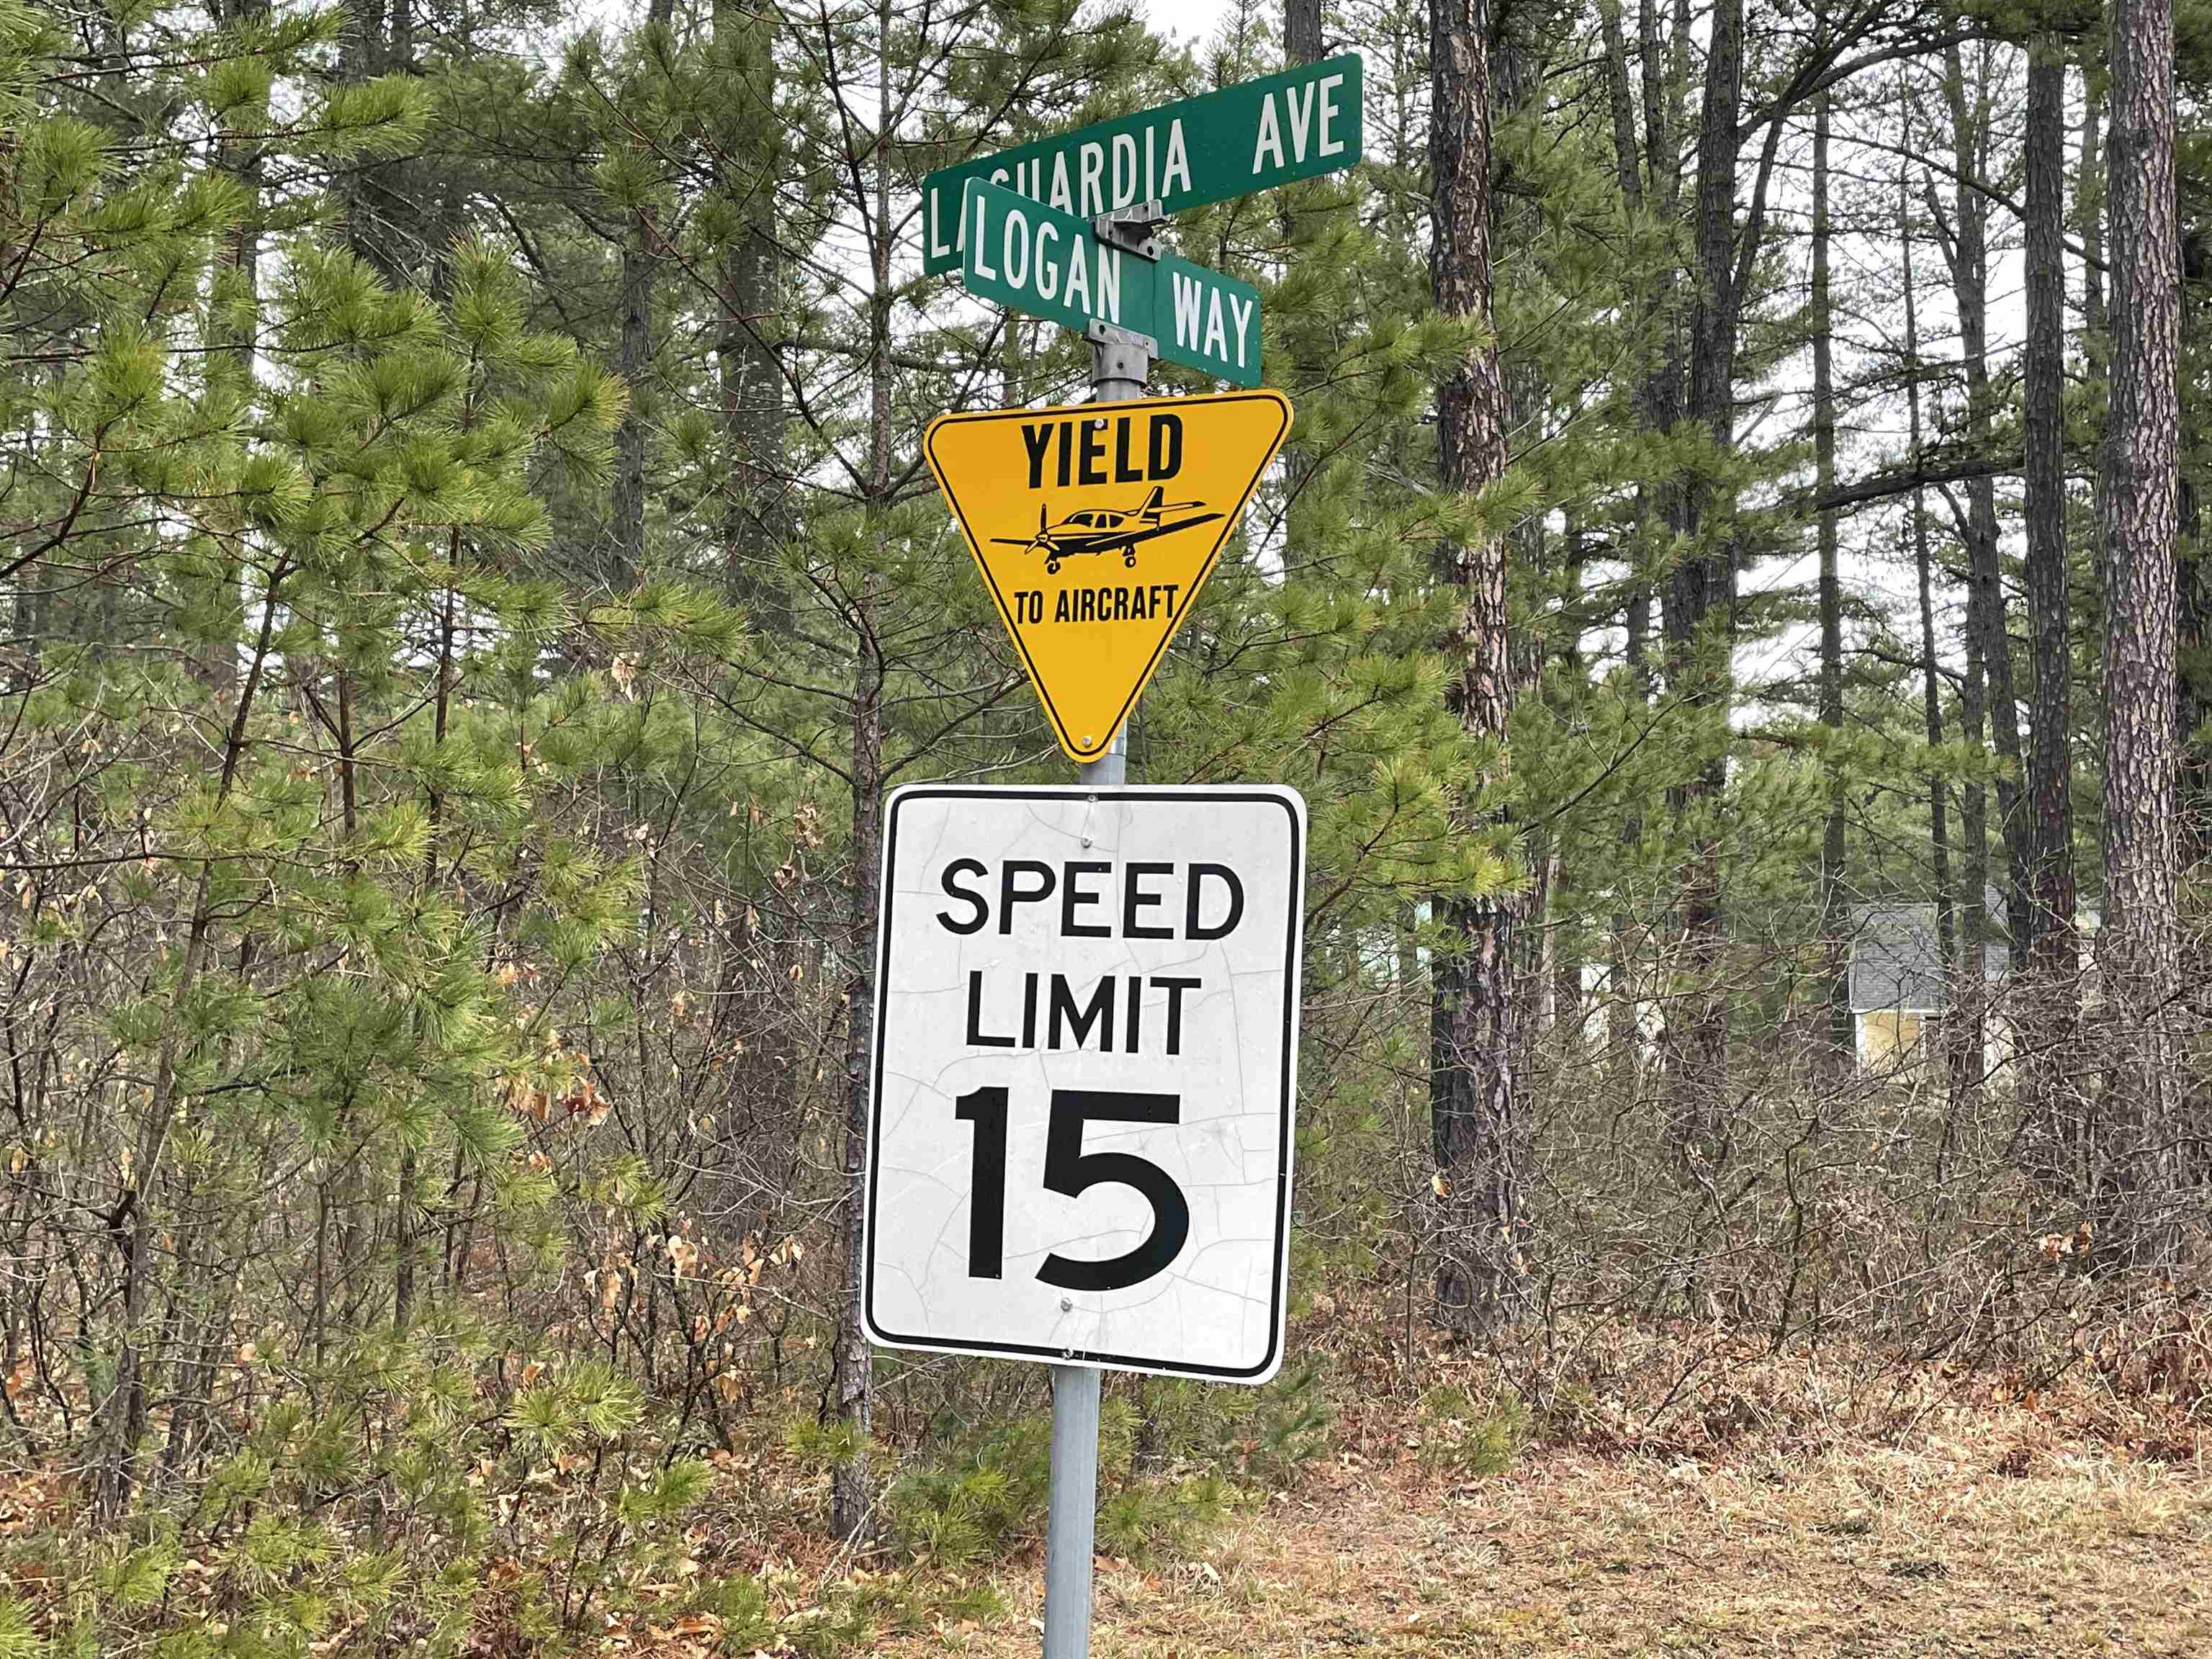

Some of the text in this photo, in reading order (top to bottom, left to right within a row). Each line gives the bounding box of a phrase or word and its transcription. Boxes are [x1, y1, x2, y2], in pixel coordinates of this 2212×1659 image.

[1252, 73, 1344, 174] AVE
[974, 194, 1253, 368] LOGAN WAY
[1021, 414, 1184, 489] YIELD
[1014, 585, 1179, 624] TO AIRCRAFT
[935, 858, 1245, 940] SPEED
[966, 971, 1202, 1055] LIMIT
[955, 1086, 1190, 1291] 15
